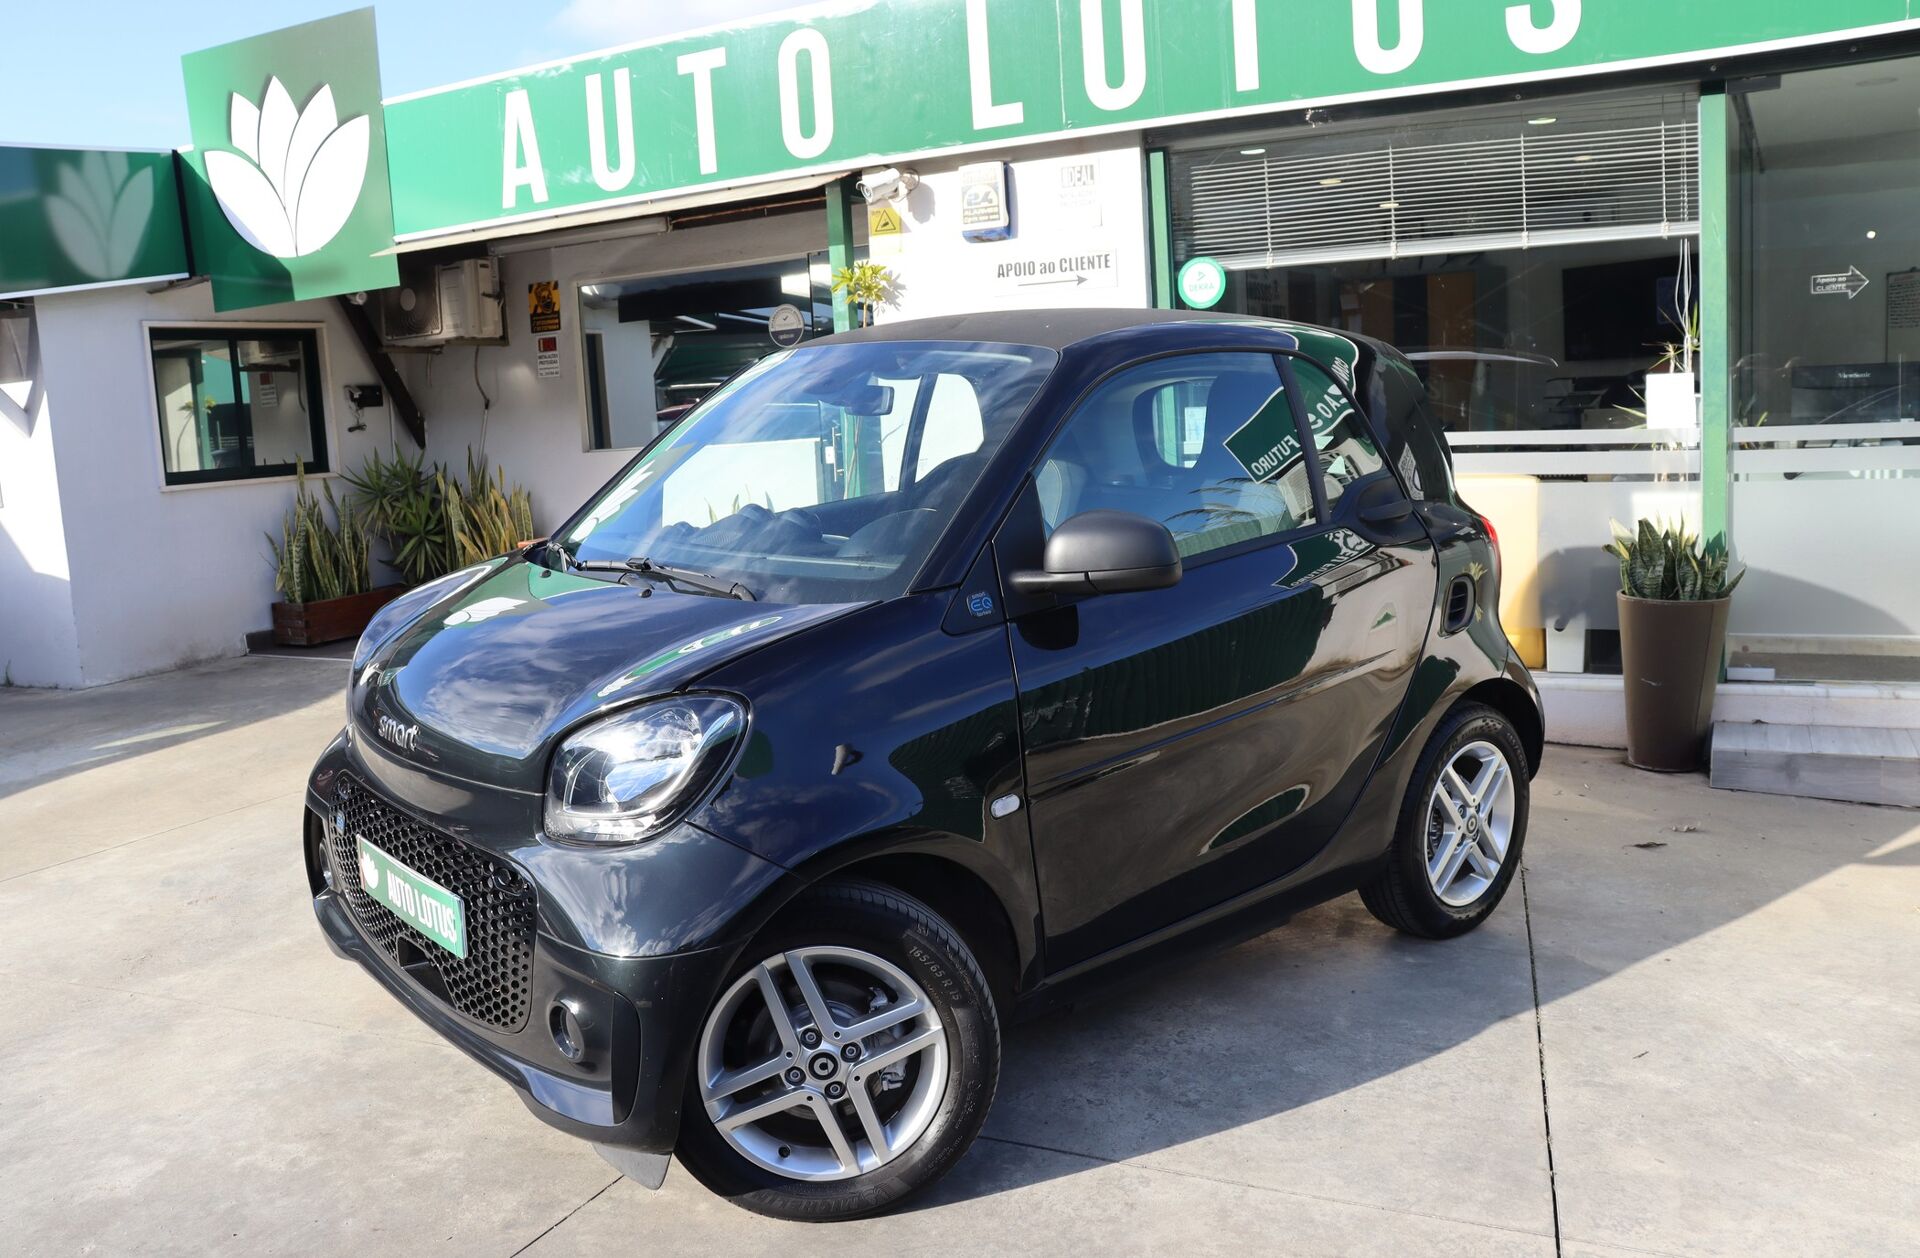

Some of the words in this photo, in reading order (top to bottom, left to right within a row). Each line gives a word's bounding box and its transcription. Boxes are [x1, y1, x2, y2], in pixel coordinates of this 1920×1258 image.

[501, 27, 834, 210] AUTO
[997, 260, 1036, 278] APOIO
[1039, 261, 1056, 275] ao
[1059, 253, 1111, 273] CLIENTE
[1816, 283, 1847, 292] CLIENTE
[378, 715, 419, 752] smart
[387, 869, 416, 918] AUTO
[414, 888, 458, 944] LOTUS
[909, 945, 946, 978] 165/65
